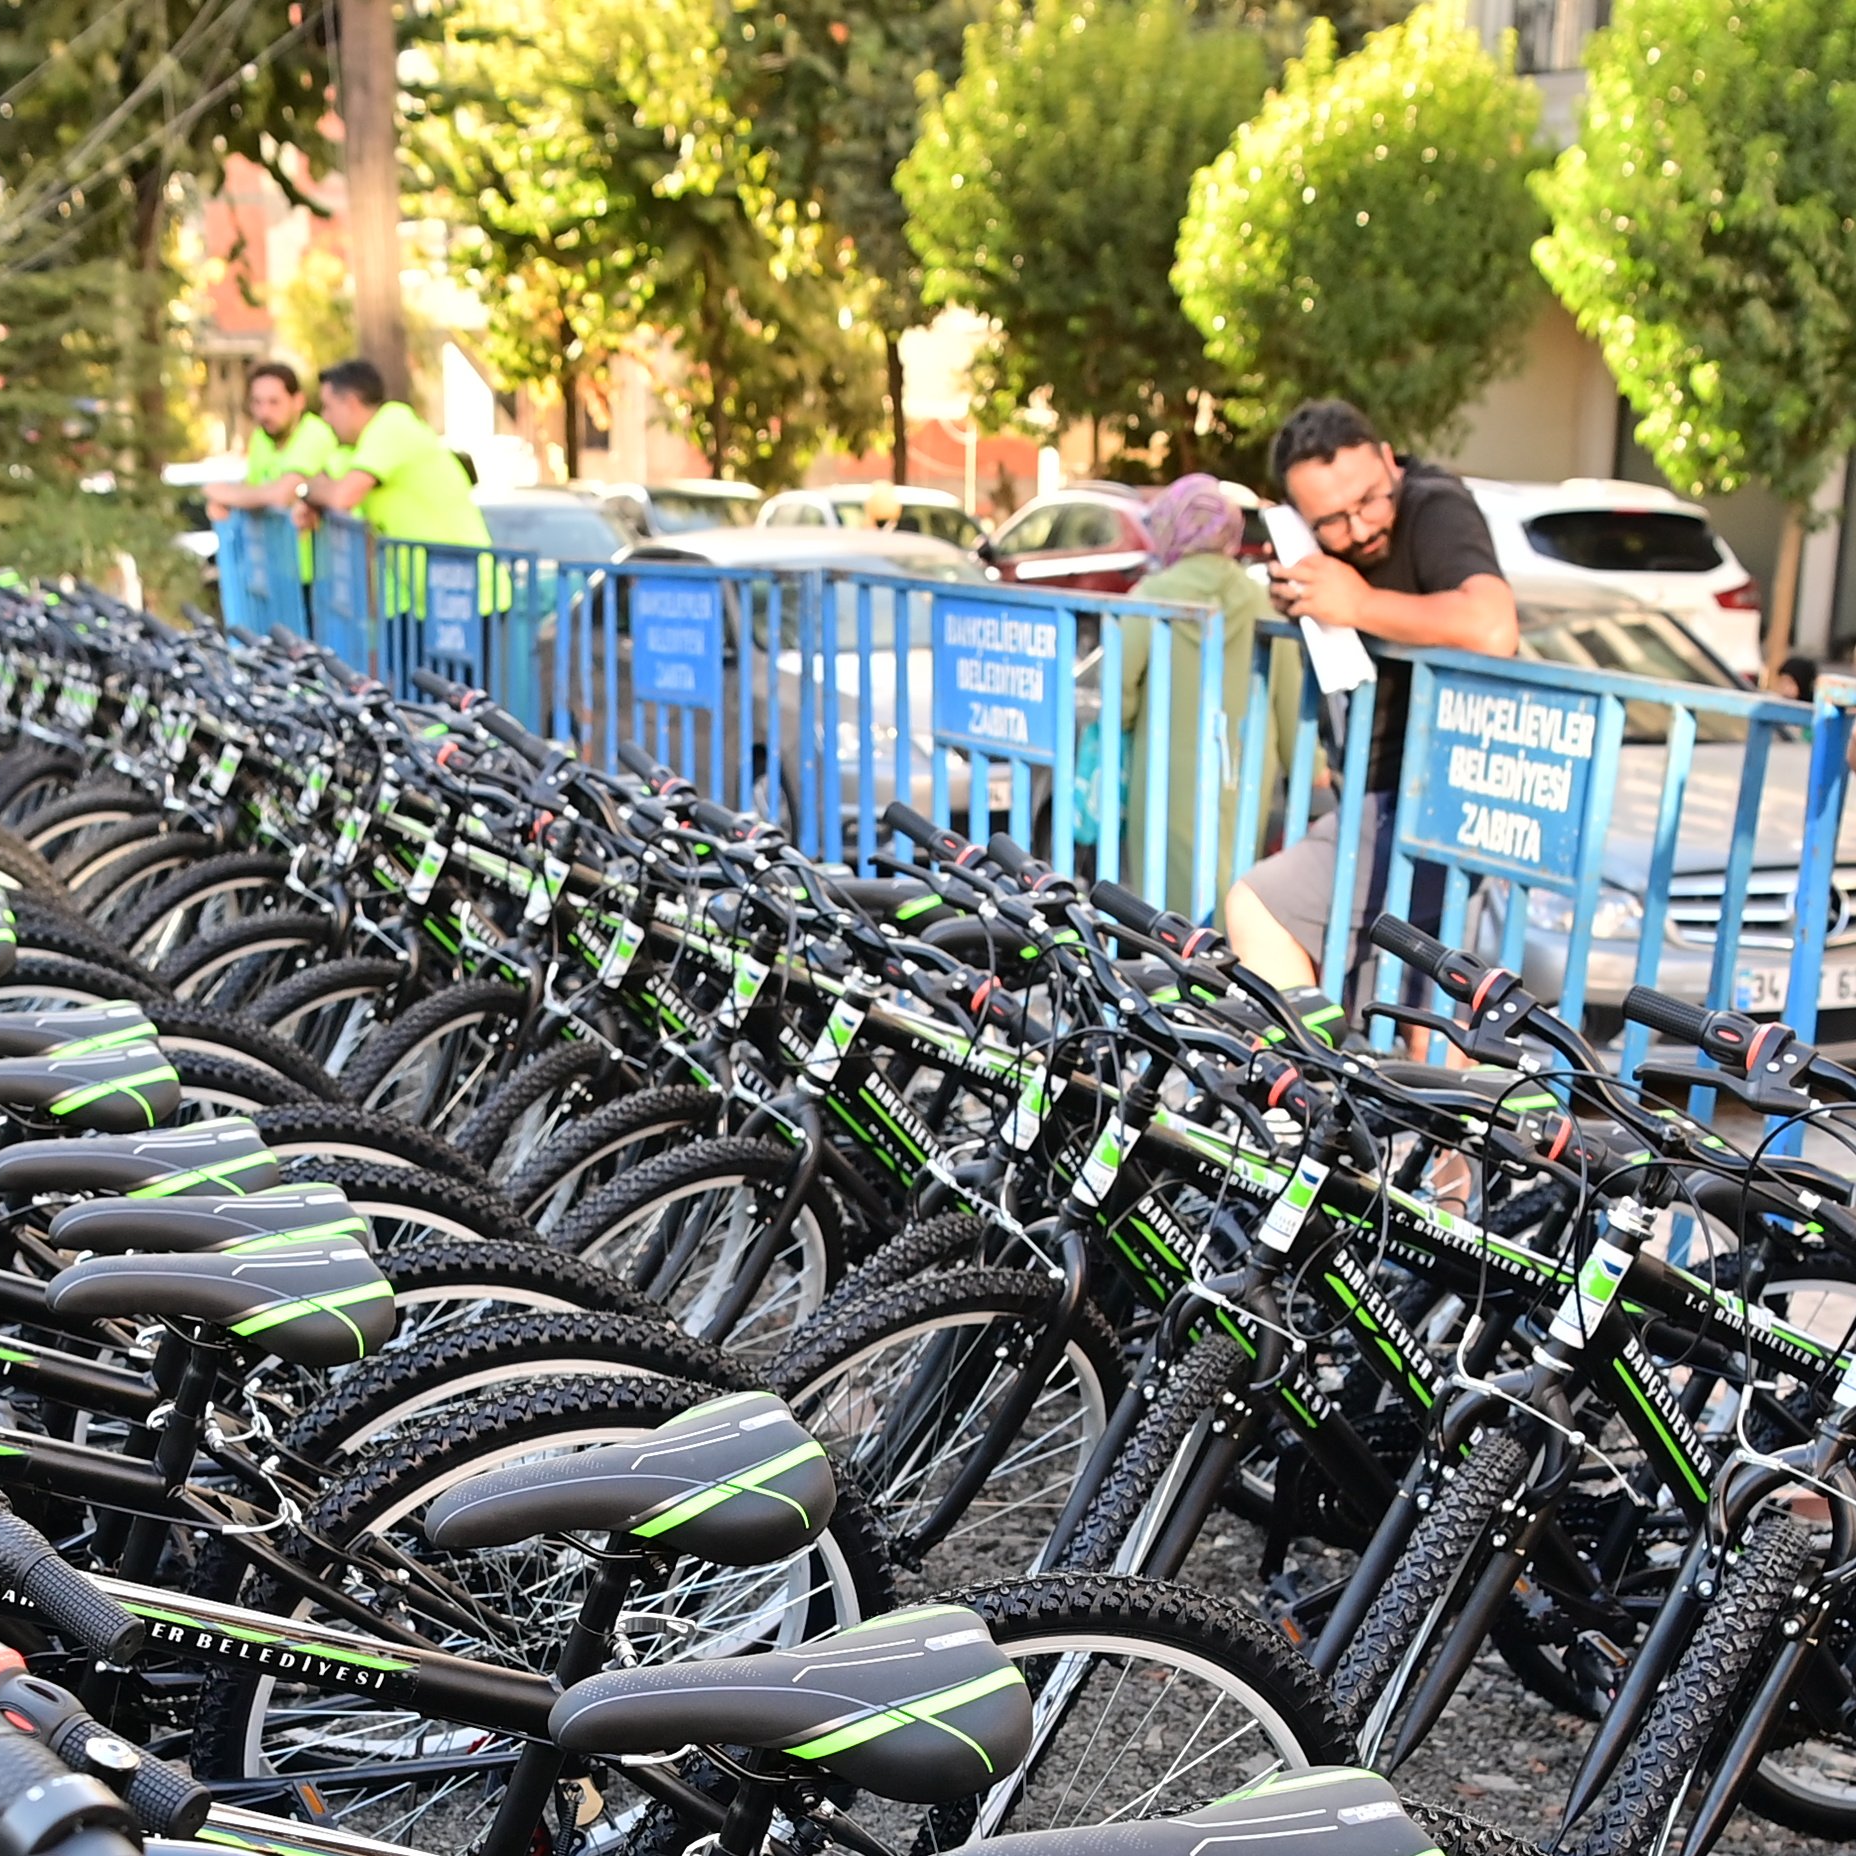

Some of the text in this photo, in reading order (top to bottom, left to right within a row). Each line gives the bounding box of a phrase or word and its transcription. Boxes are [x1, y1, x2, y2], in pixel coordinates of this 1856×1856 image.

[1436, 686, 1596, 760] BAHÇELİEVLER
[1448, 744, 1573, 814] BELEDİYESİ
[1456, 801, 1542, 864] ZABITA
[1752, 973, 1780, 1003] 34
[1622, 1337, 1714, 1478] BAHÇELİEVLER
[195, 1631, 386, 1690] BELEDİYESİ
